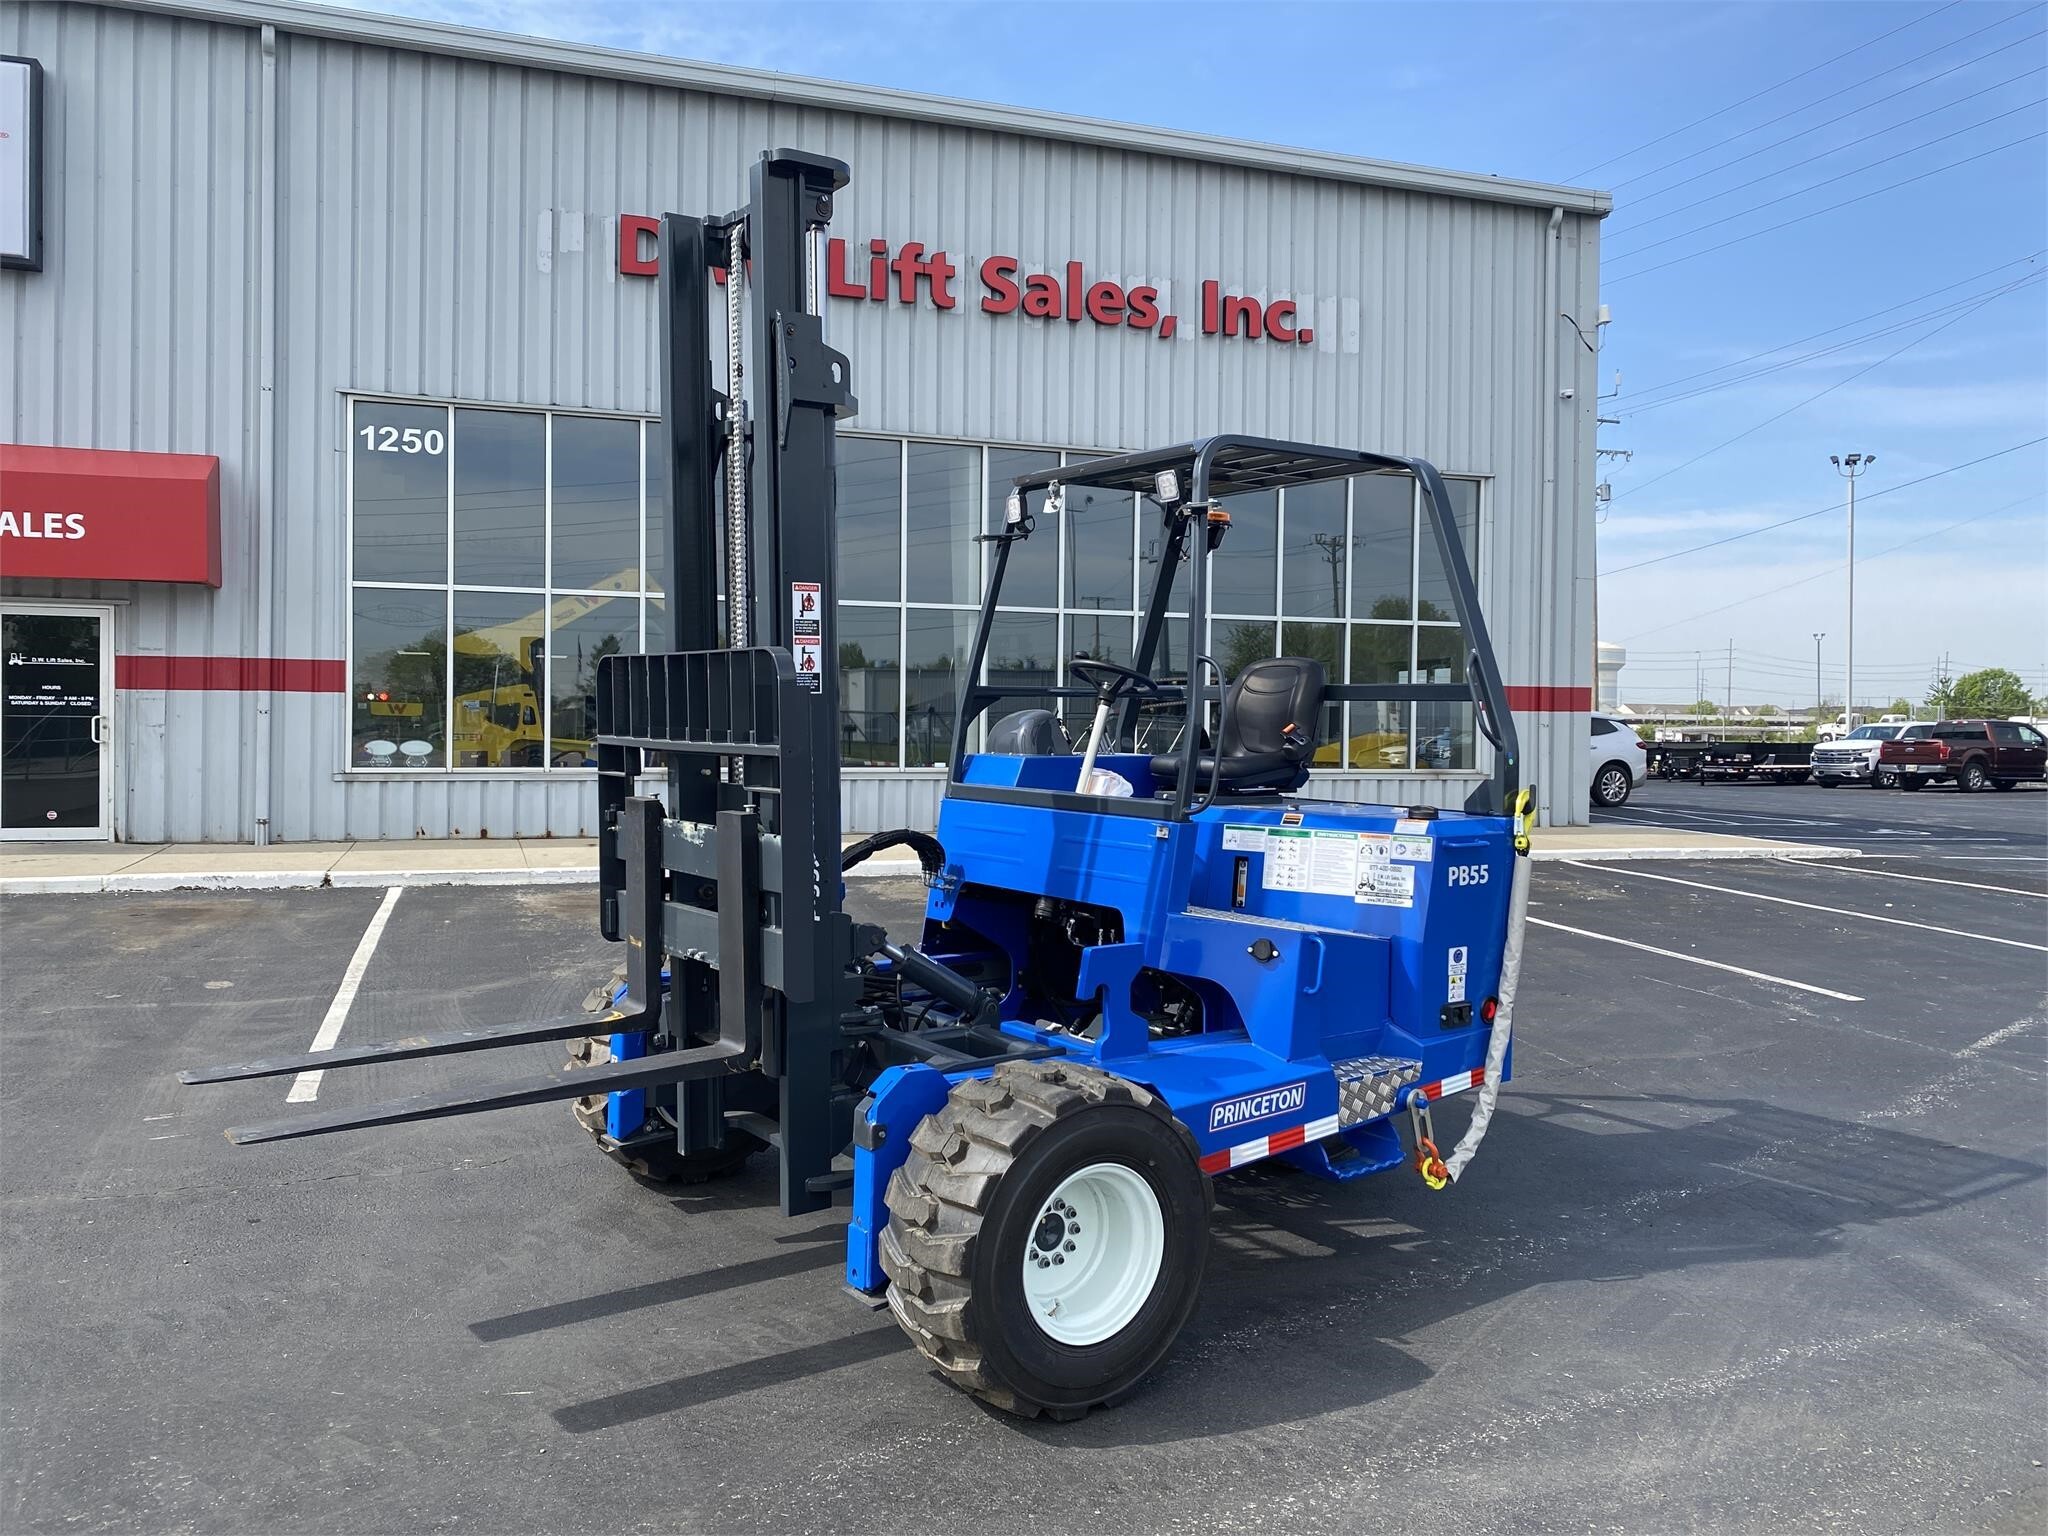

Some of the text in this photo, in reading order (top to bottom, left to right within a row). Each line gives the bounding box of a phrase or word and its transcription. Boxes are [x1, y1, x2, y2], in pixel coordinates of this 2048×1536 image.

[828, 238, 956, 309] Lift
[980, 256, 1177, 338] Sales,
[1201, 279, 1313, 343] Inc.
[360, 425, 444, 456] 1250
[0, 511, 86, 540] ALES
[1448, 863, 1489, 887] PB55
[1213, 1087, 1302, 1127] PRINCETON
